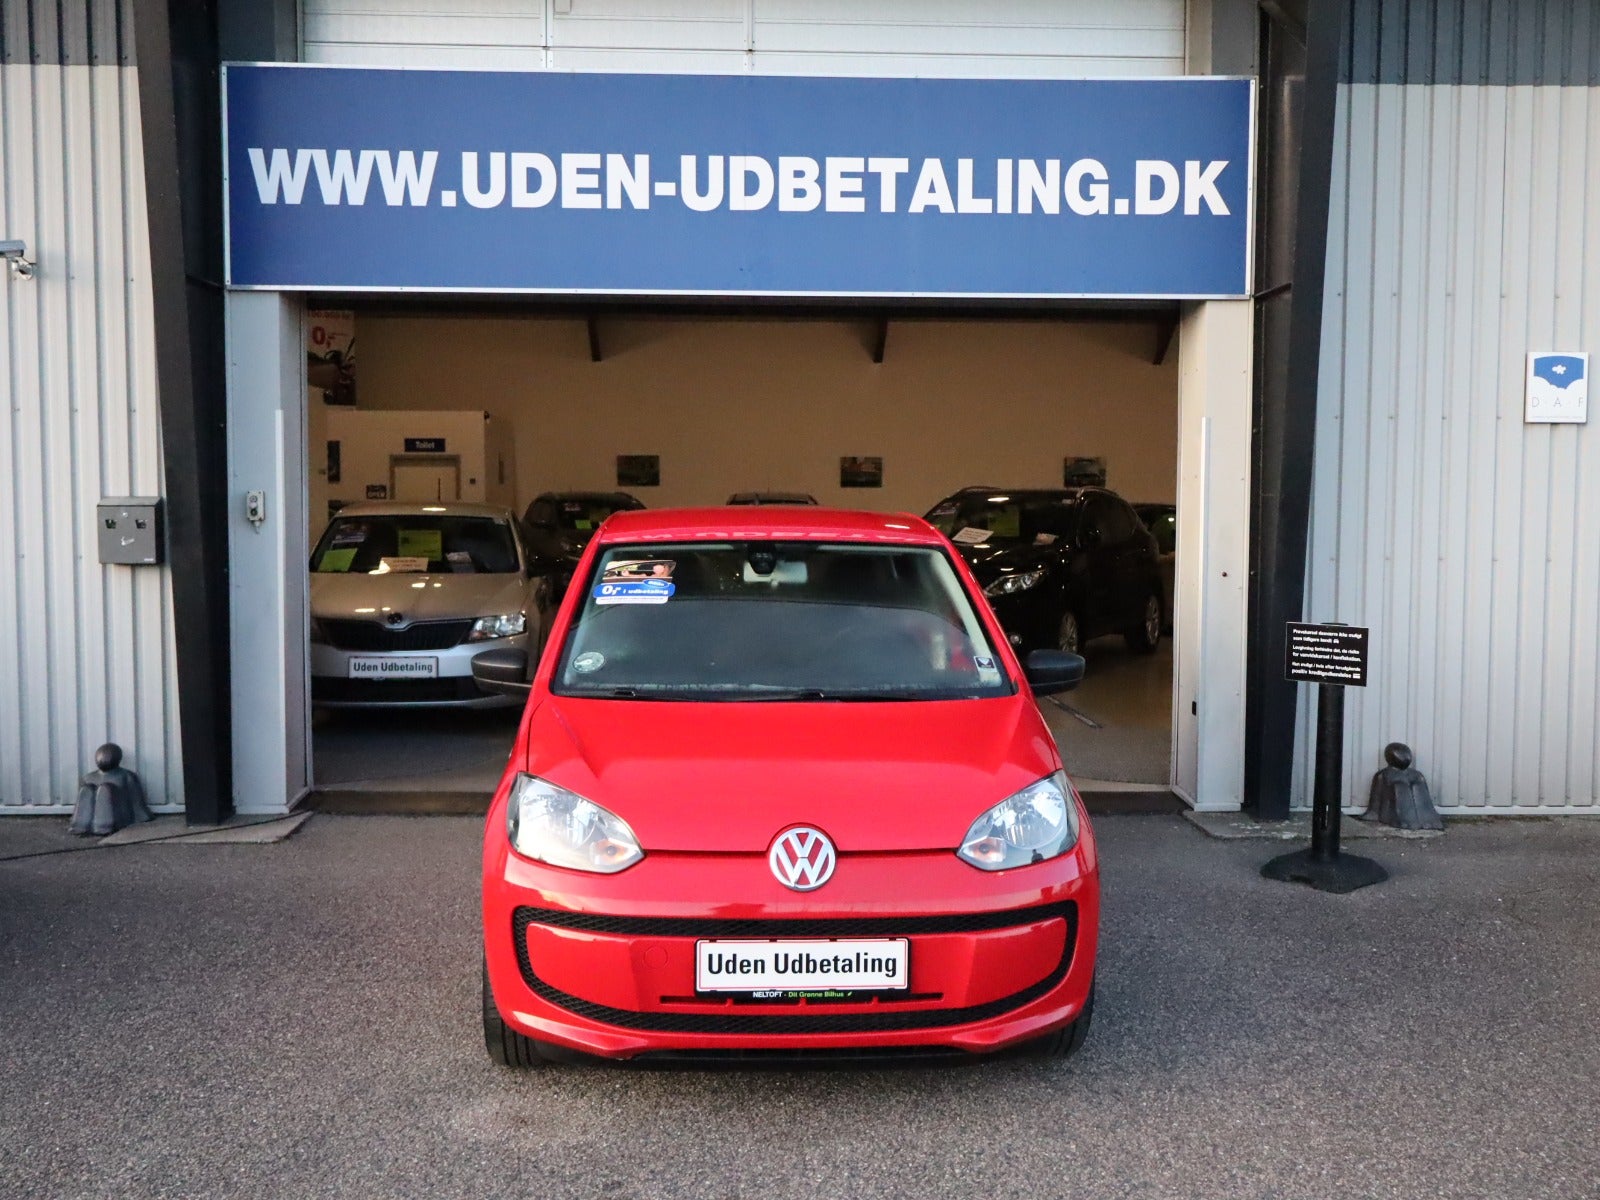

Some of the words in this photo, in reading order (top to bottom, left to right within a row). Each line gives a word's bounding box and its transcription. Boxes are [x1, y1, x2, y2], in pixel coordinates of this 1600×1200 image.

[248, 147, 1231, 216] WWW.UDEN-UDBETALING.DK
[416, 441, 435, 449] Toilet
[353, 662, 378, 672] Uden
[381, 662, 433, 674] Udbetaling
[708, 953, 766, 974] Uden
[774, 952, 897, 977] Udbetaling
